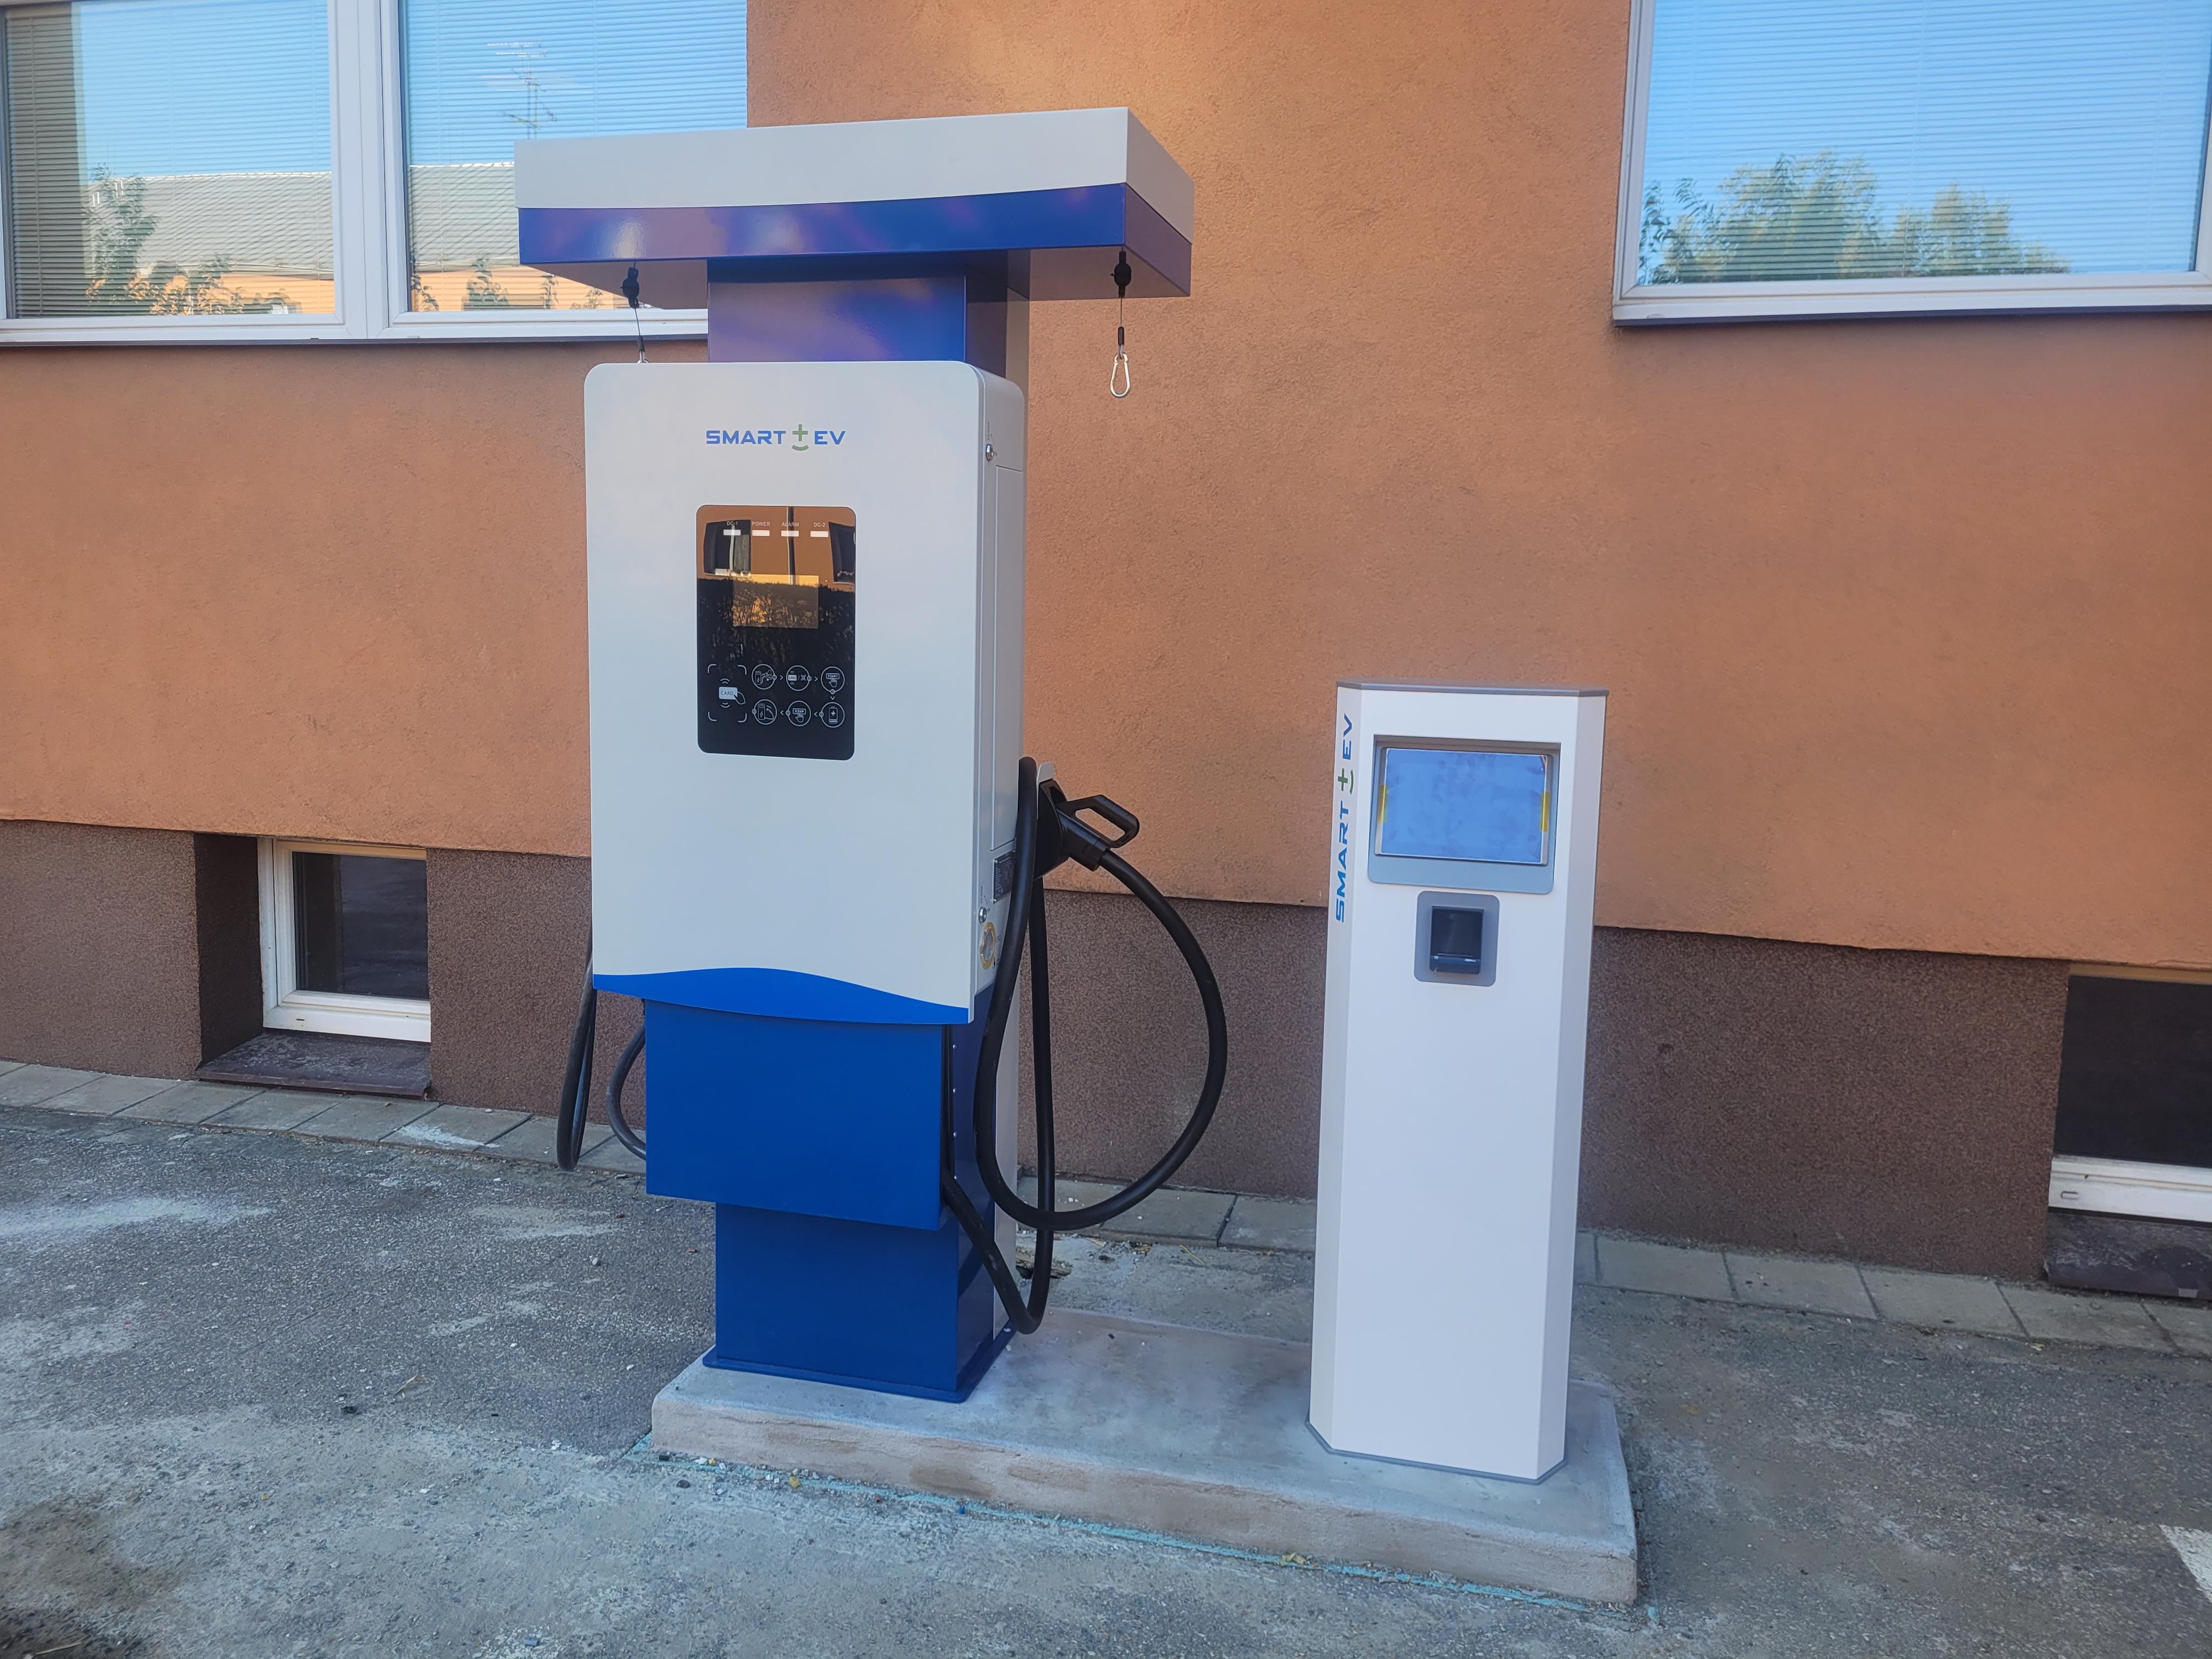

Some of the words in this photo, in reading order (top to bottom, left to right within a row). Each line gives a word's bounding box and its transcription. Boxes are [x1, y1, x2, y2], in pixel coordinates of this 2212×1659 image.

[706, 430, 787, 445] SMART
[814, 430, 846, 445] EV
[1335, 800, 1349, 923] SMART
[1342, 713, 1353, 760] EV
